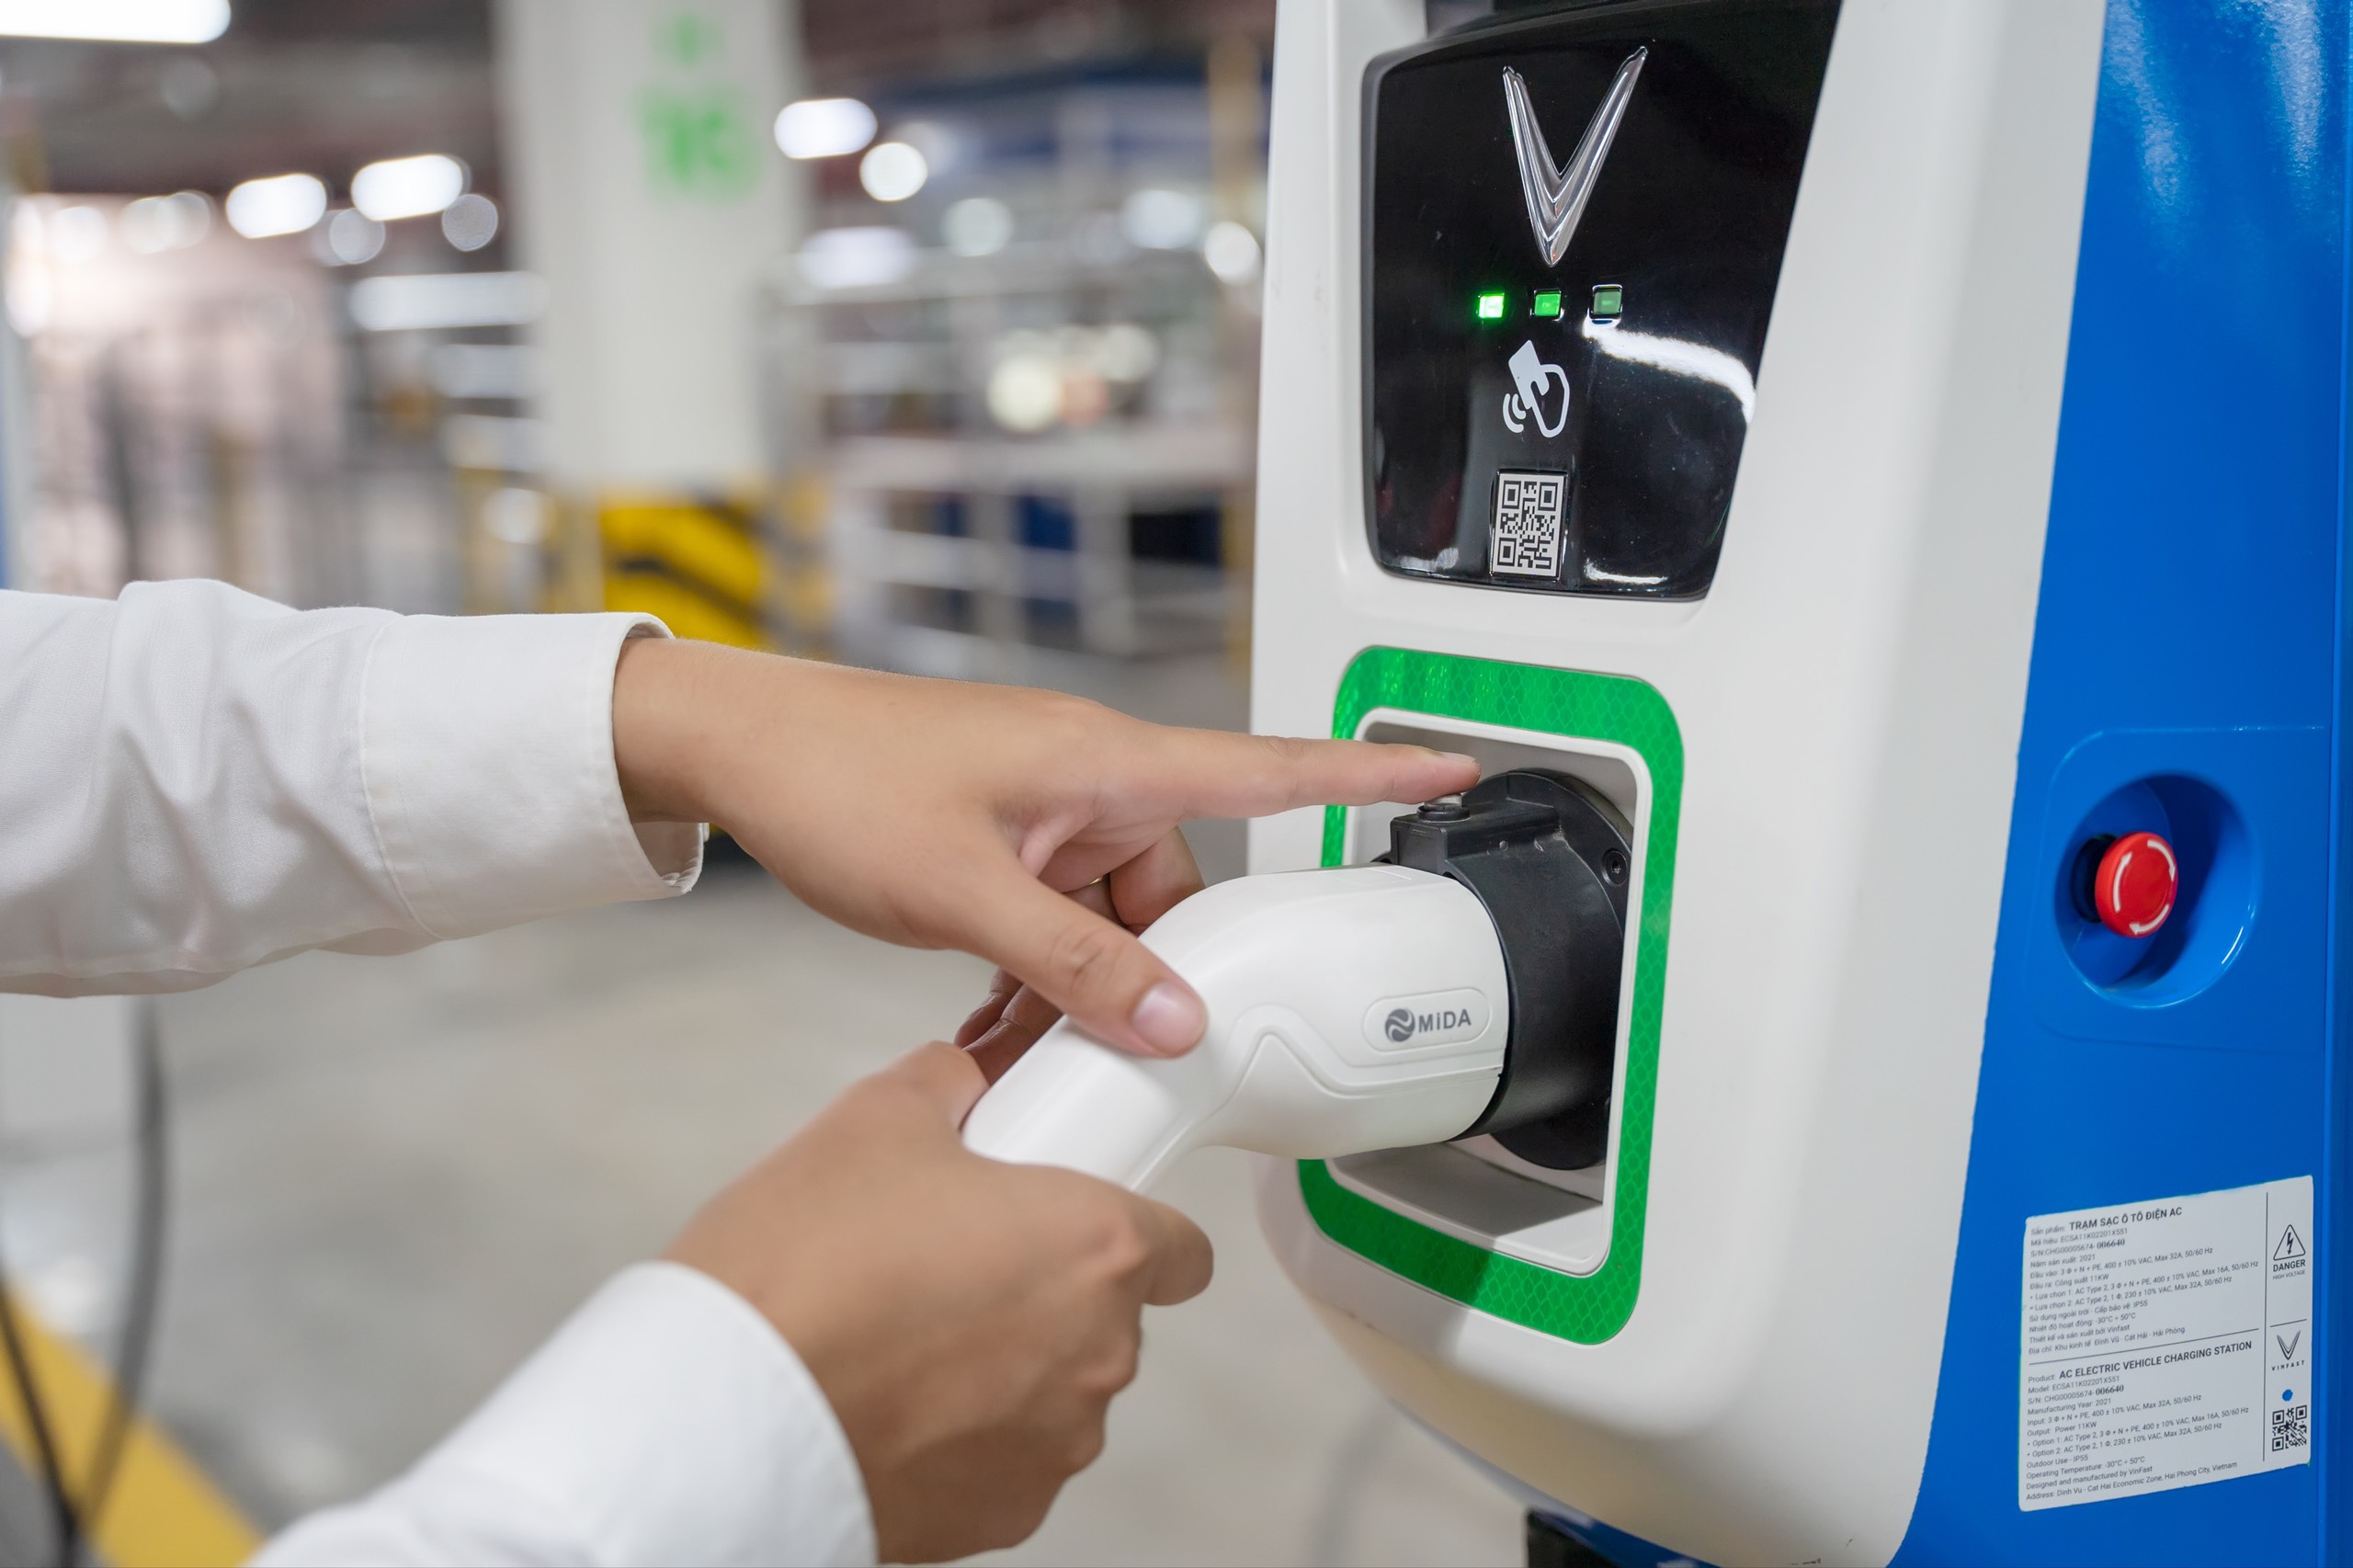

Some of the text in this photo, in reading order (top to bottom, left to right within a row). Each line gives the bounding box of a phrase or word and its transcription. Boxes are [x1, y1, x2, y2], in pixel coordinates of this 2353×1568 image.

[2070, 1207, 2182, 1231] TRẠM SẠC Ô TÔ ĐIỆN AC
[2060, 1228, 2127, 1243] ECSA11K02201X551
[2096, 1239, 2125, 1249] 006640
[2079, 1254, 2095, 1262] 2021
[2185, 1248, 2203, 1258] 50/60
[2273, 1259, 2306, 1272] DANGER
[2087, 1286, 2102, 1294] Type
[2231, 1262, 2249, 1271] 50/60
[2285, 1269, 2306, 1278] VOLTAGE
[2087, 1297, 2102, 1305] Type
[2124, 1290, 2137, 1299] 230
[2204, 1277, 2223, 1286] 50/60
[2133, 1299, 2148, 1308] IP55
[2059, 1370, 2072, 1379] AC
[2075, 1364, 2120, 1377] ELECTRIC
[2123, 1357, 2162, 1370] VEHICLE
[2164, 1349, 2212, 1364] CHARGING
[2214, 1342, 2252, 1355] STATION
[2271, 1360, 2305, 1371] VINFAST
[2052, 1375, 2119, 1391] ECSA11K02201X551
[2095, 1385, 2124, 1395] 006640
[2027, 1404, 2076, 1415] Manufacturing
[2095, 1398, 2111, 1406] 2021
[2173, 1395, 2192, 1405] 50/60
[2032, 1439, 2055, 1447] Option
[2221, 1408, 2240, 1418] 50/60
[2078, 1421, 2097, 1429] 11KW
[2032, 1449, 2055, 1458] Option
[2113, 1438, 2126, 1446] 230
[2194, 1423, 2213, 1433] 50/60
[2026, 1460, 2054, 1469] Outdoor
[2073, 1454, 2089, 1462] IP55
[2026, 1470, 2059, 1480] Operating
[2026, 1480, 2057, 1490] Designed
[2072, 1471, 2118, 1484] manufactured
[2129, 1466, 2153, 1475] VinFast
[2057, 1488, 2072, 1496] Dinh
[2113, 1478, 2144, 1488] Economic
[2177, 1469, 2197, 1478] Phong
[2212, 1462, 2237, 1471] Vietnam
